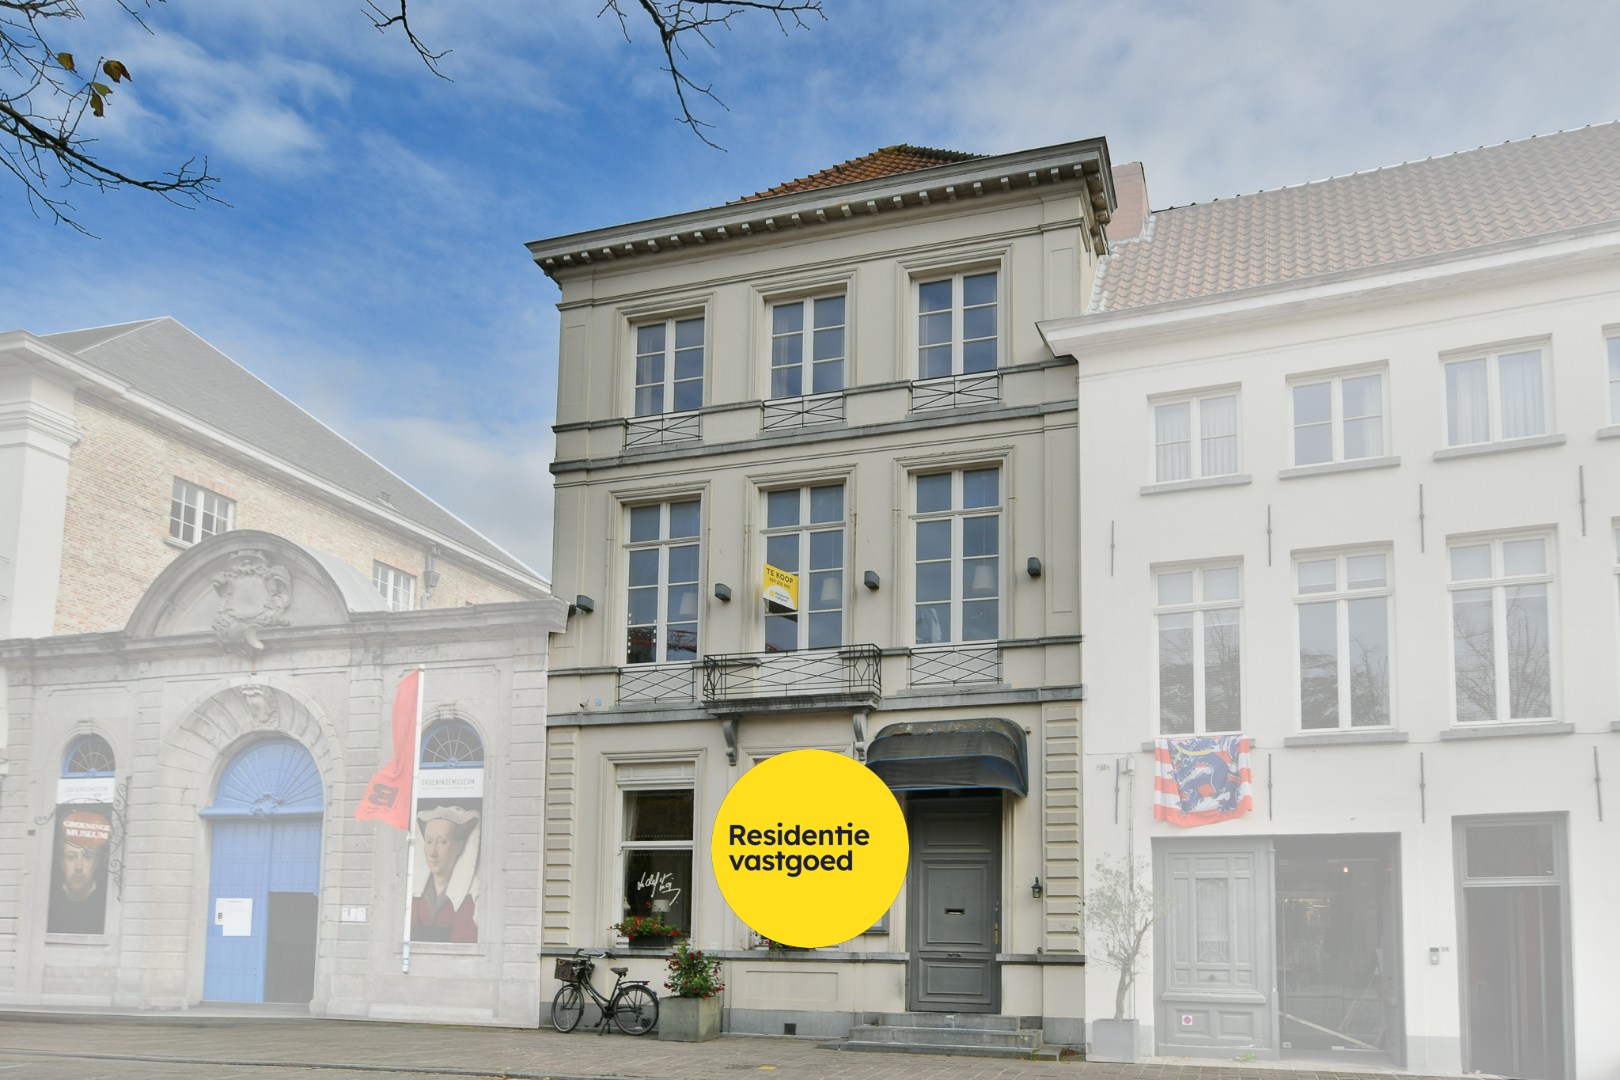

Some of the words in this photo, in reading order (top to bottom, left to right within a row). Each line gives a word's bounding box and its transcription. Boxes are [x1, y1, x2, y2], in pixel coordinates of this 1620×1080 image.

[766, 567, 775, 576] TE
[775, 572, 793, 583] KOOP
[63, 821, 111, 831] GROENINGE
[65, 829, 108, 839] MUSEUM
